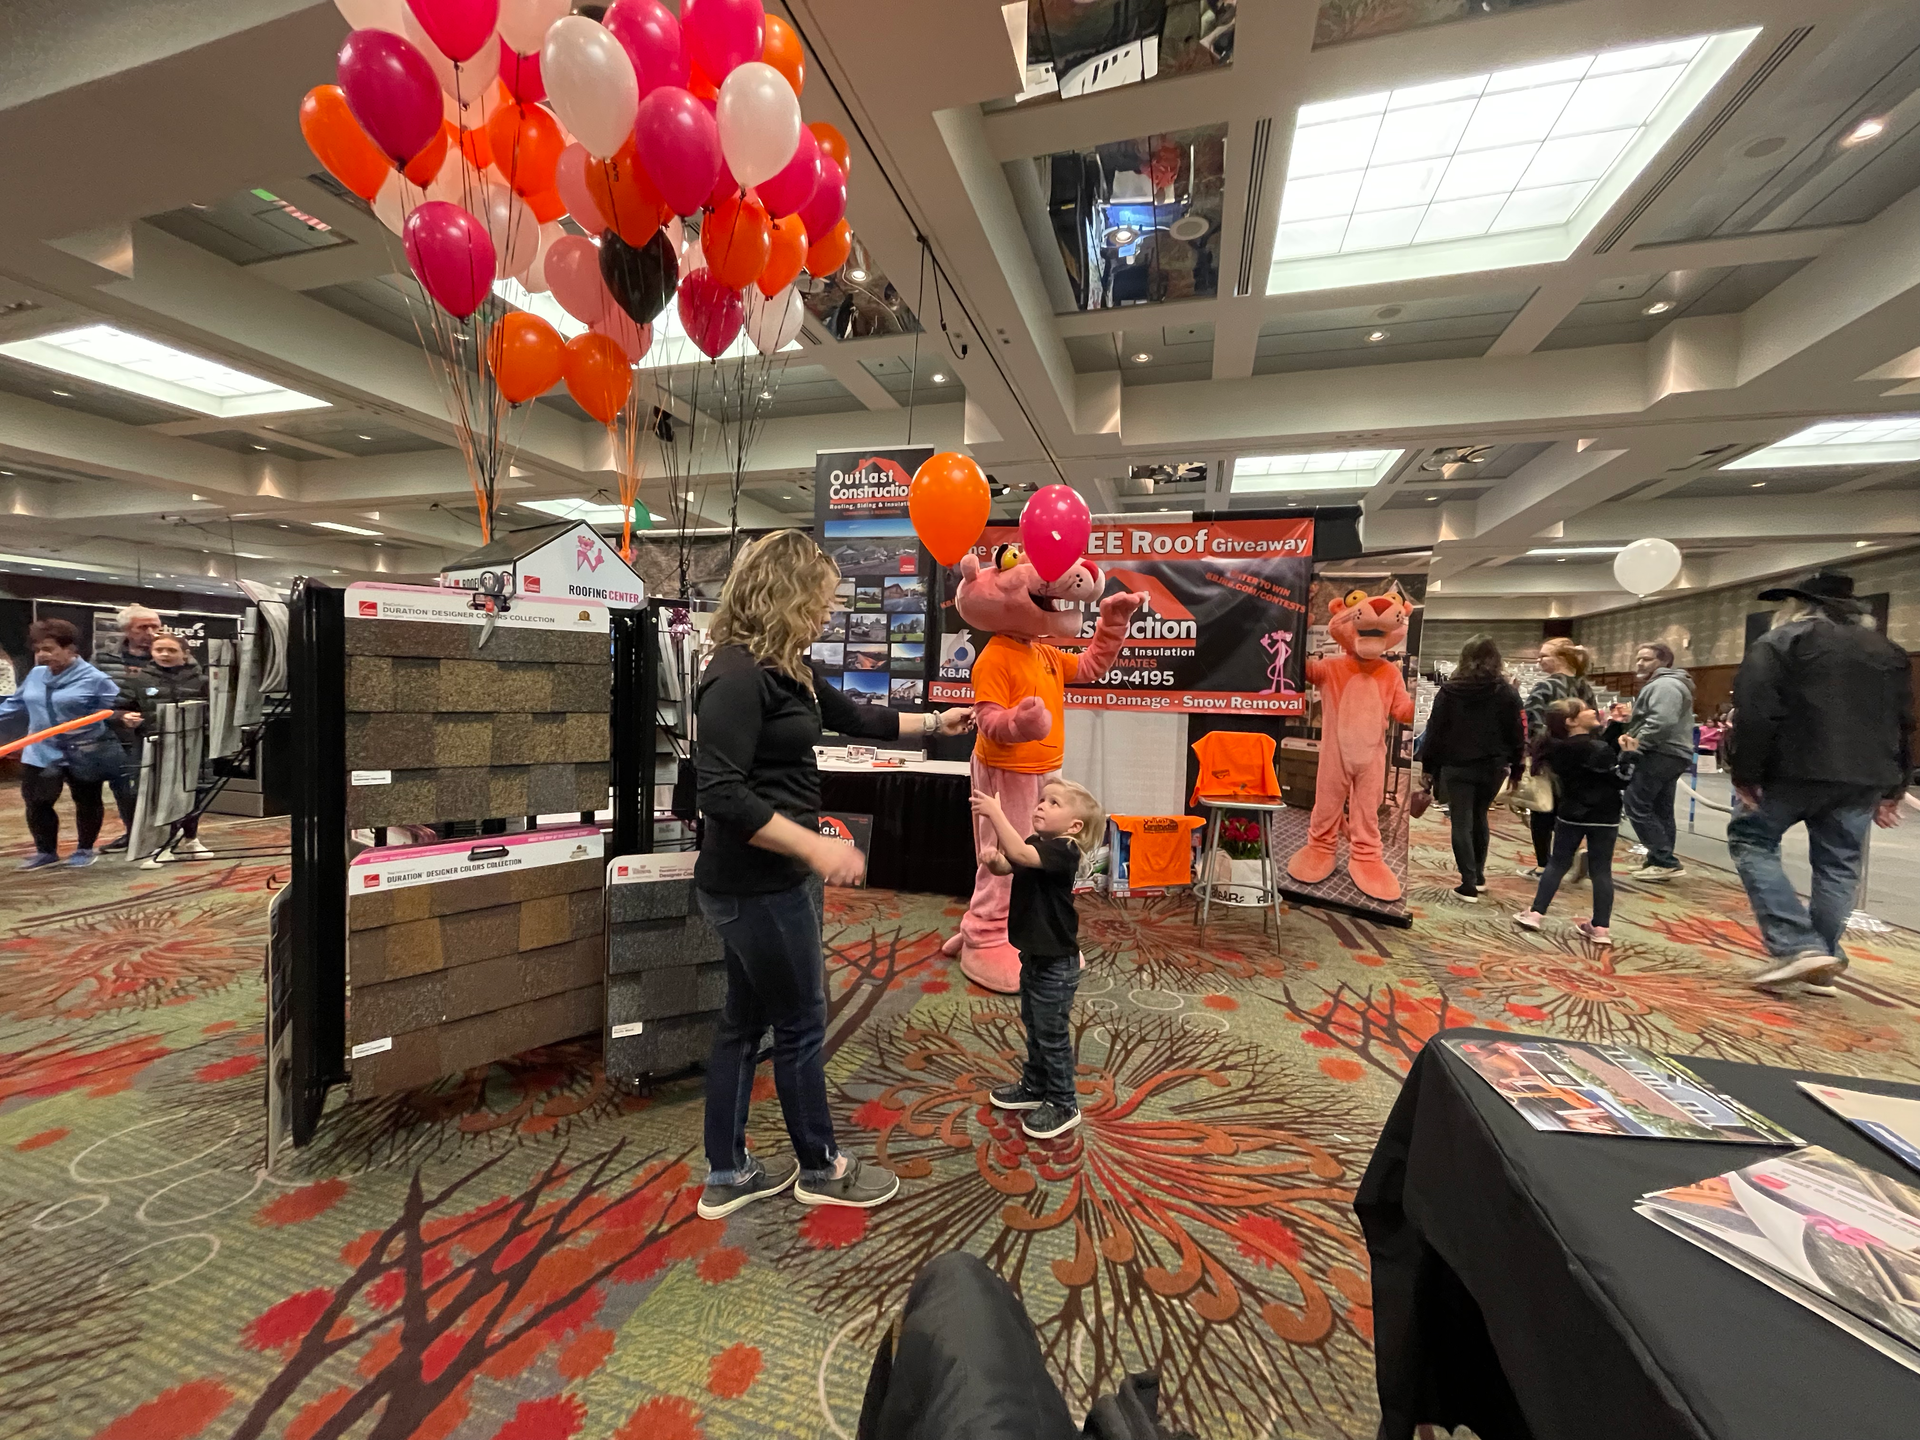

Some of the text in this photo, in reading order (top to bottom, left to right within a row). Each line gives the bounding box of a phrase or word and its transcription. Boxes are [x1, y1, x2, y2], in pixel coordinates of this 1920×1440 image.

[830, 469, 894, 485] OutLast
[829, 482, 912, 500] Constructio
[1085, 528, 1308, 555] EE Roof Giveaway
[568, 584, 639, 604] ROOFING CENTER
[1259, 578, 1272, 590] TO
[1272, 584, 1292, 598] WIN
[431, 609, 474, 619] DESIGNER
[509, 614, 555, 624] COLLECTION
[1122, 647, 1195, 657] & Insulation
[939, 667, 971, 679] KBJR
[1091, 669, 1175, 686] 09-4195
[932, 685, 975, 699] Roofi
[1106, 693, 1171, 708] Damage
[1183, 695, 1227, 708] Snow
[1230, 696, 1303, 710] Removal
[426, 866, 459, 878] DESIGNER
[460, 863, 485, 873] COLORS
[486, 858, 522, 869] COLLECTION
